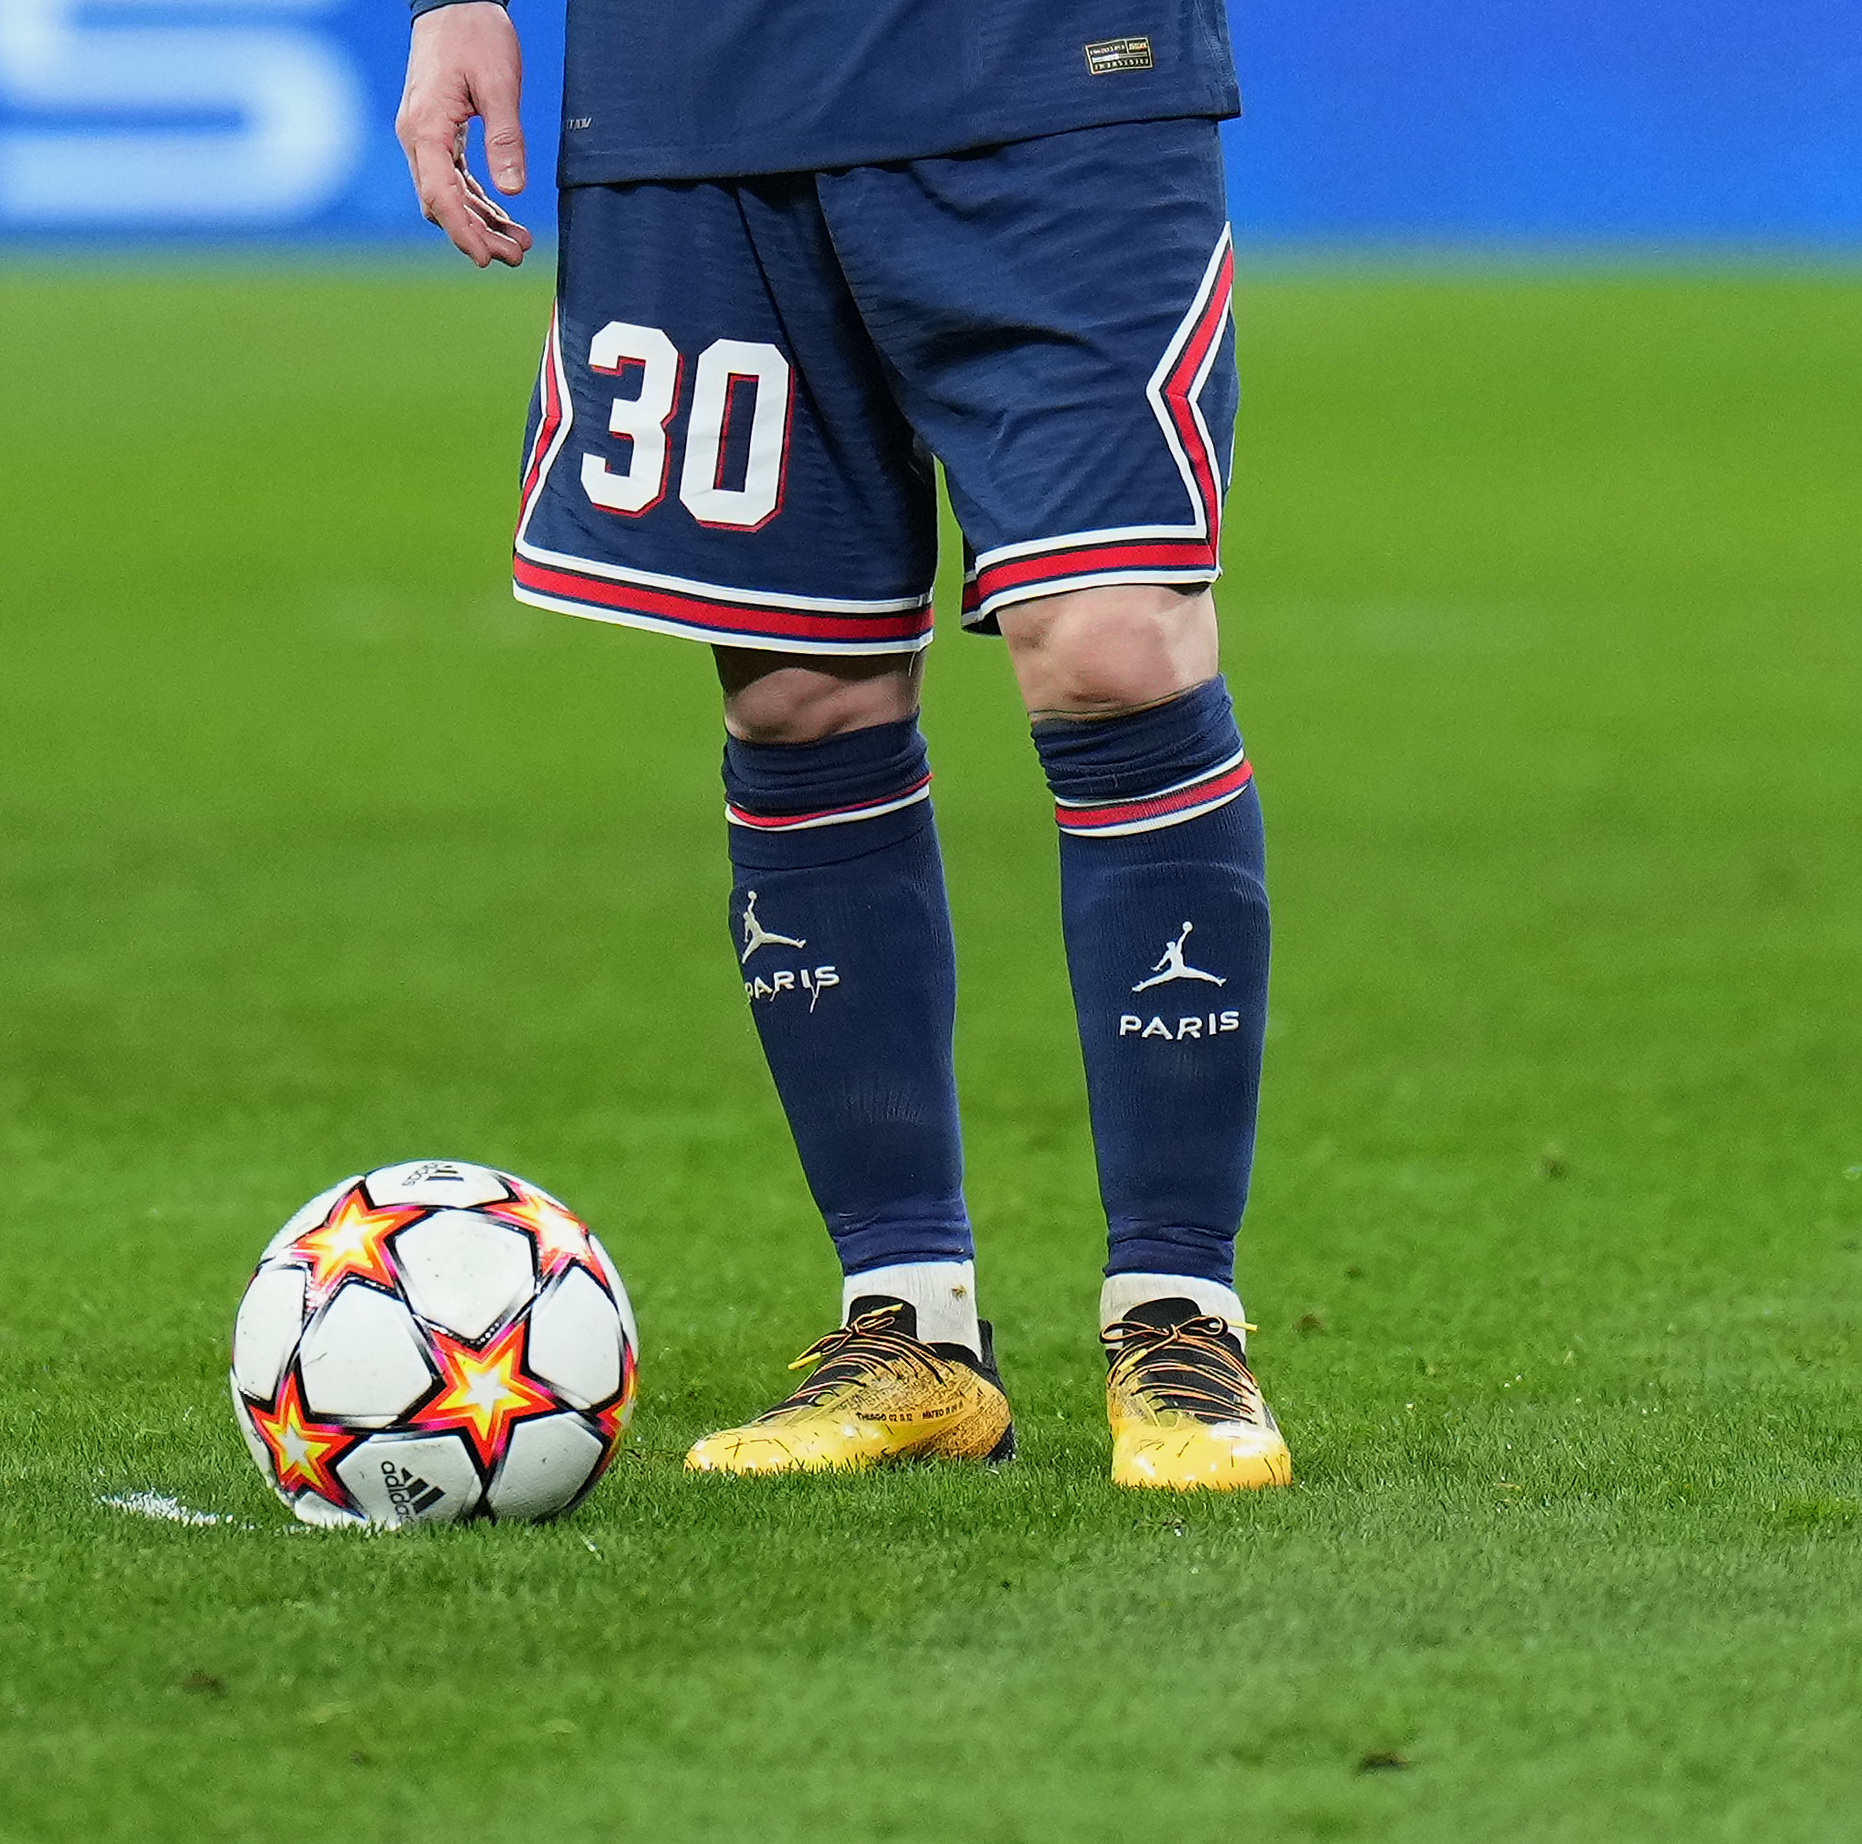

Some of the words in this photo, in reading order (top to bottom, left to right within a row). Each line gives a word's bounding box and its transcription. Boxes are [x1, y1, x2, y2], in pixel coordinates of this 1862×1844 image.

[579, 320, 793, 533] 30
[744, 965, 841, 1002] PARIS
[1119, 1010, 1241, 1041] PARIS
